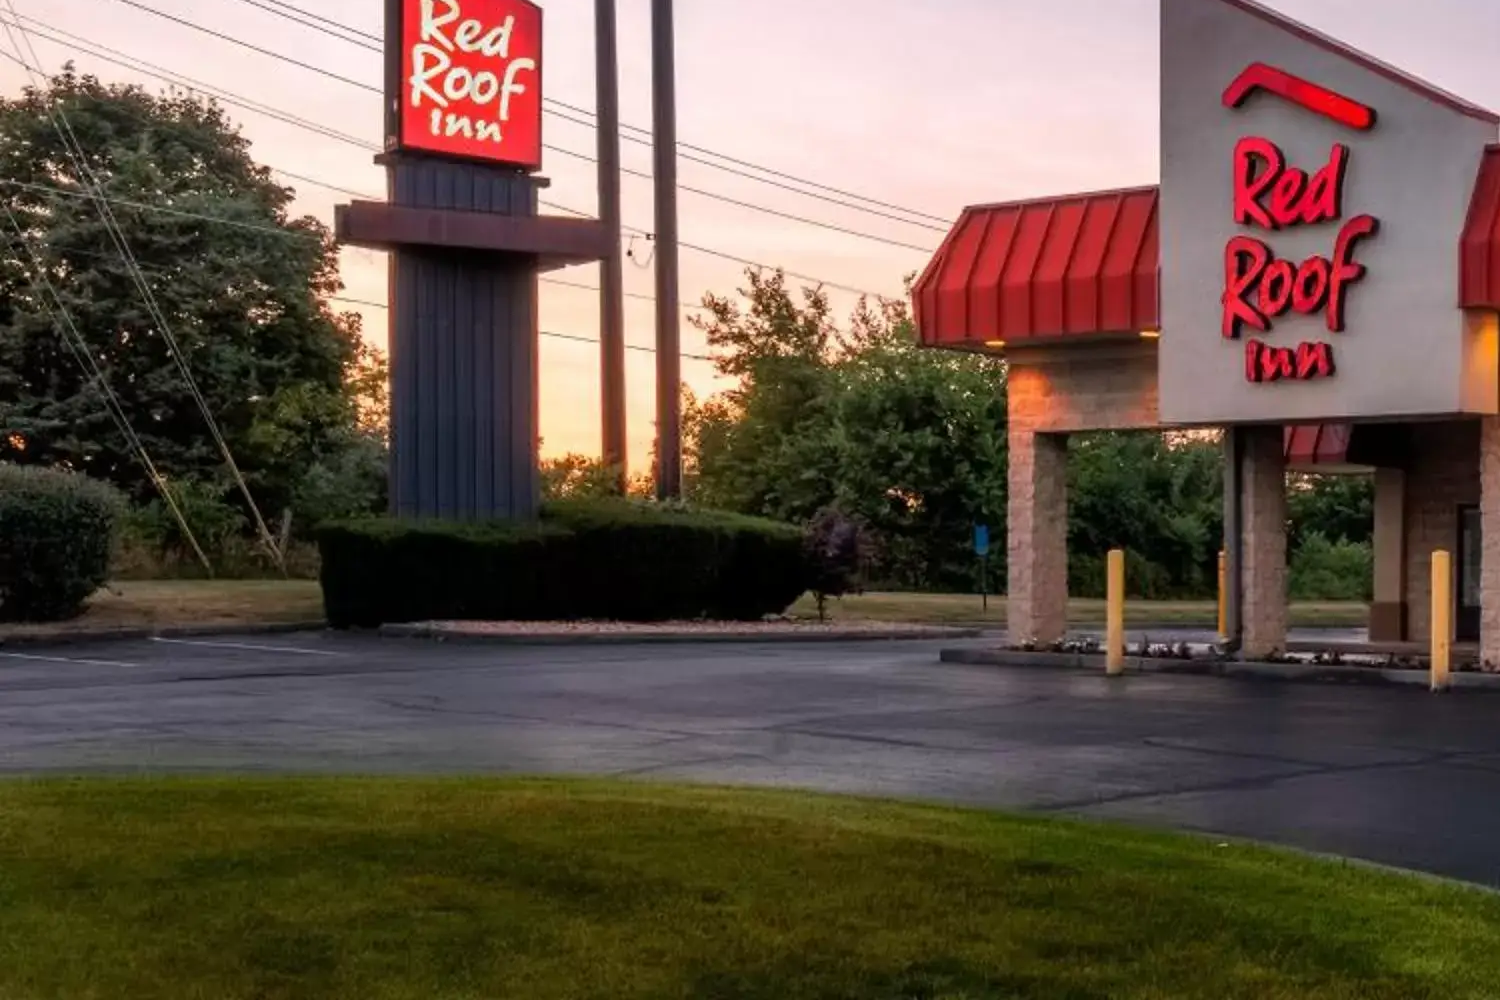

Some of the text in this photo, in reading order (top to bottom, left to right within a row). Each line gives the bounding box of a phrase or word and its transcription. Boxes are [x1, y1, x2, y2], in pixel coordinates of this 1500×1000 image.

[409, 43, 535, 121] Roof
[1233, 136, 1348, 231] Red
[1222, 214, 1379, 339] Roof
